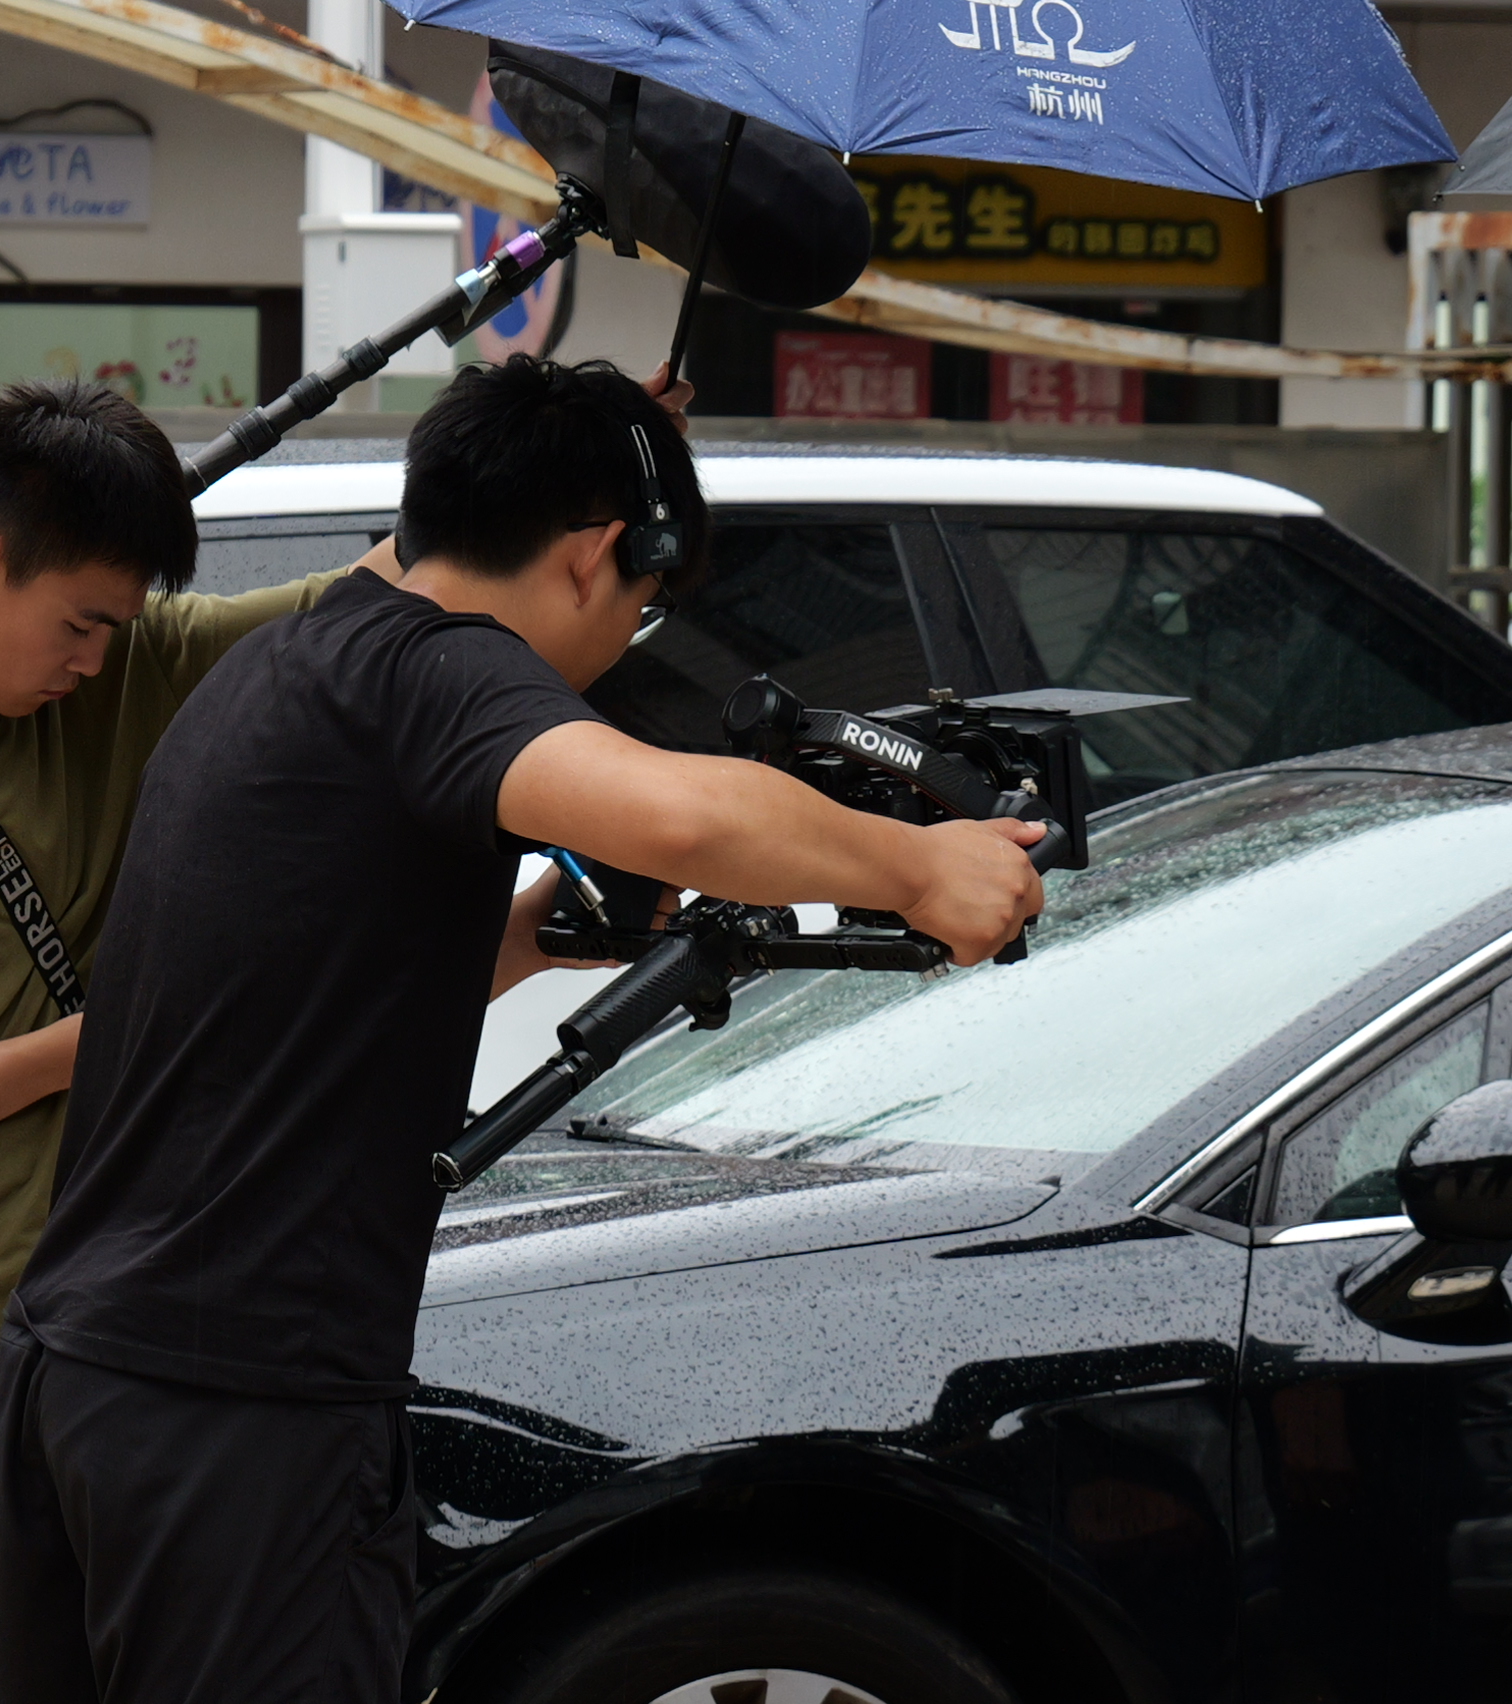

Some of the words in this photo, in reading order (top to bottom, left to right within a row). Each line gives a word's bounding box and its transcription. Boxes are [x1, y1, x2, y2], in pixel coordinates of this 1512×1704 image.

[1016, 66, 1107, 89] HANGZHOU
[1026, 83, 1104, 125] 杭州
[46, 191, 129, 216] flower
[655, 503, 666, 520] 6
[841, 720, 924, 772] RONIN
[0, 868, 76, 997] HORSE
